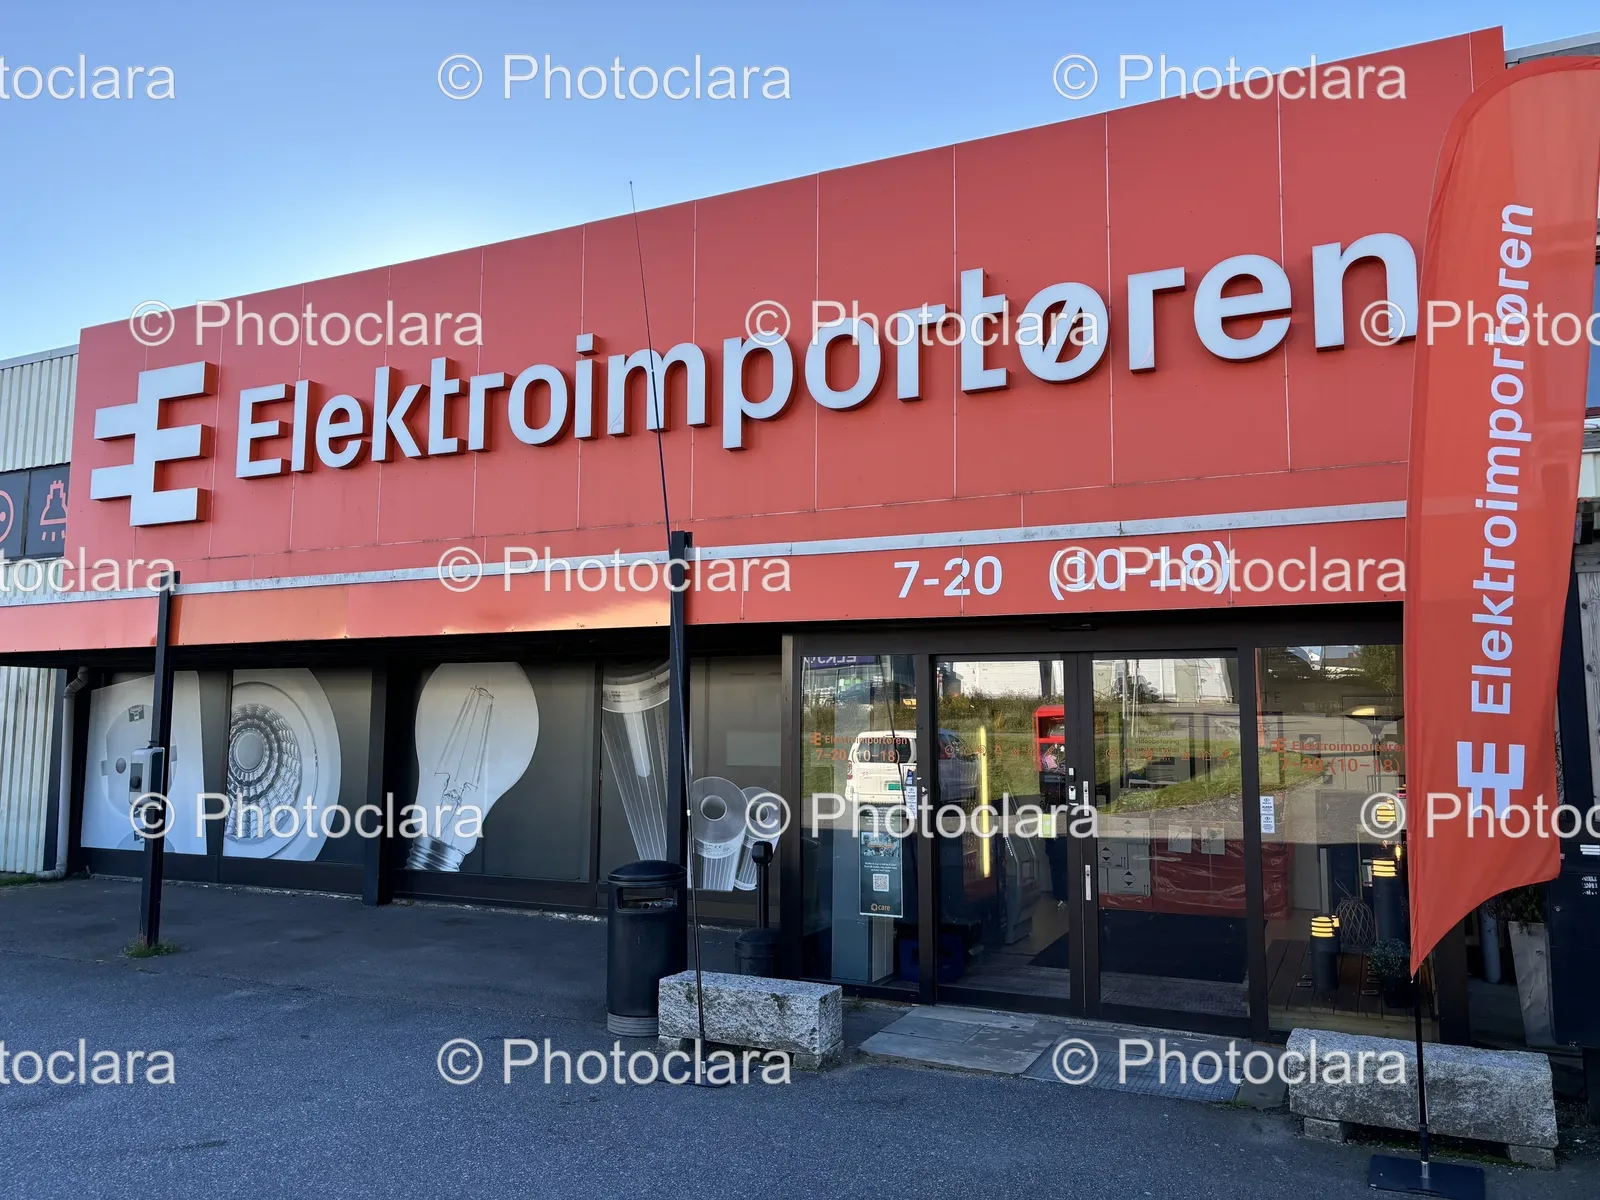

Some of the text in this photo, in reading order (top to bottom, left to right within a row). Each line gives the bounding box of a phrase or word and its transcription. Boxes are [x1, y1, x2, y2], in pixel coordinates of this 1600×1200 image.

[236, 232, 1419, 481] Elektroimportøren
[1471, 204, 1534, 715] Elektroimportøren
[894, 540, 1231, 601] 7-20 (10-18)
[1280, 757, 1324, 772] 7-20
[1330, 757, 1401, 775] (10-18)
[877, 903, 891, 912] care
